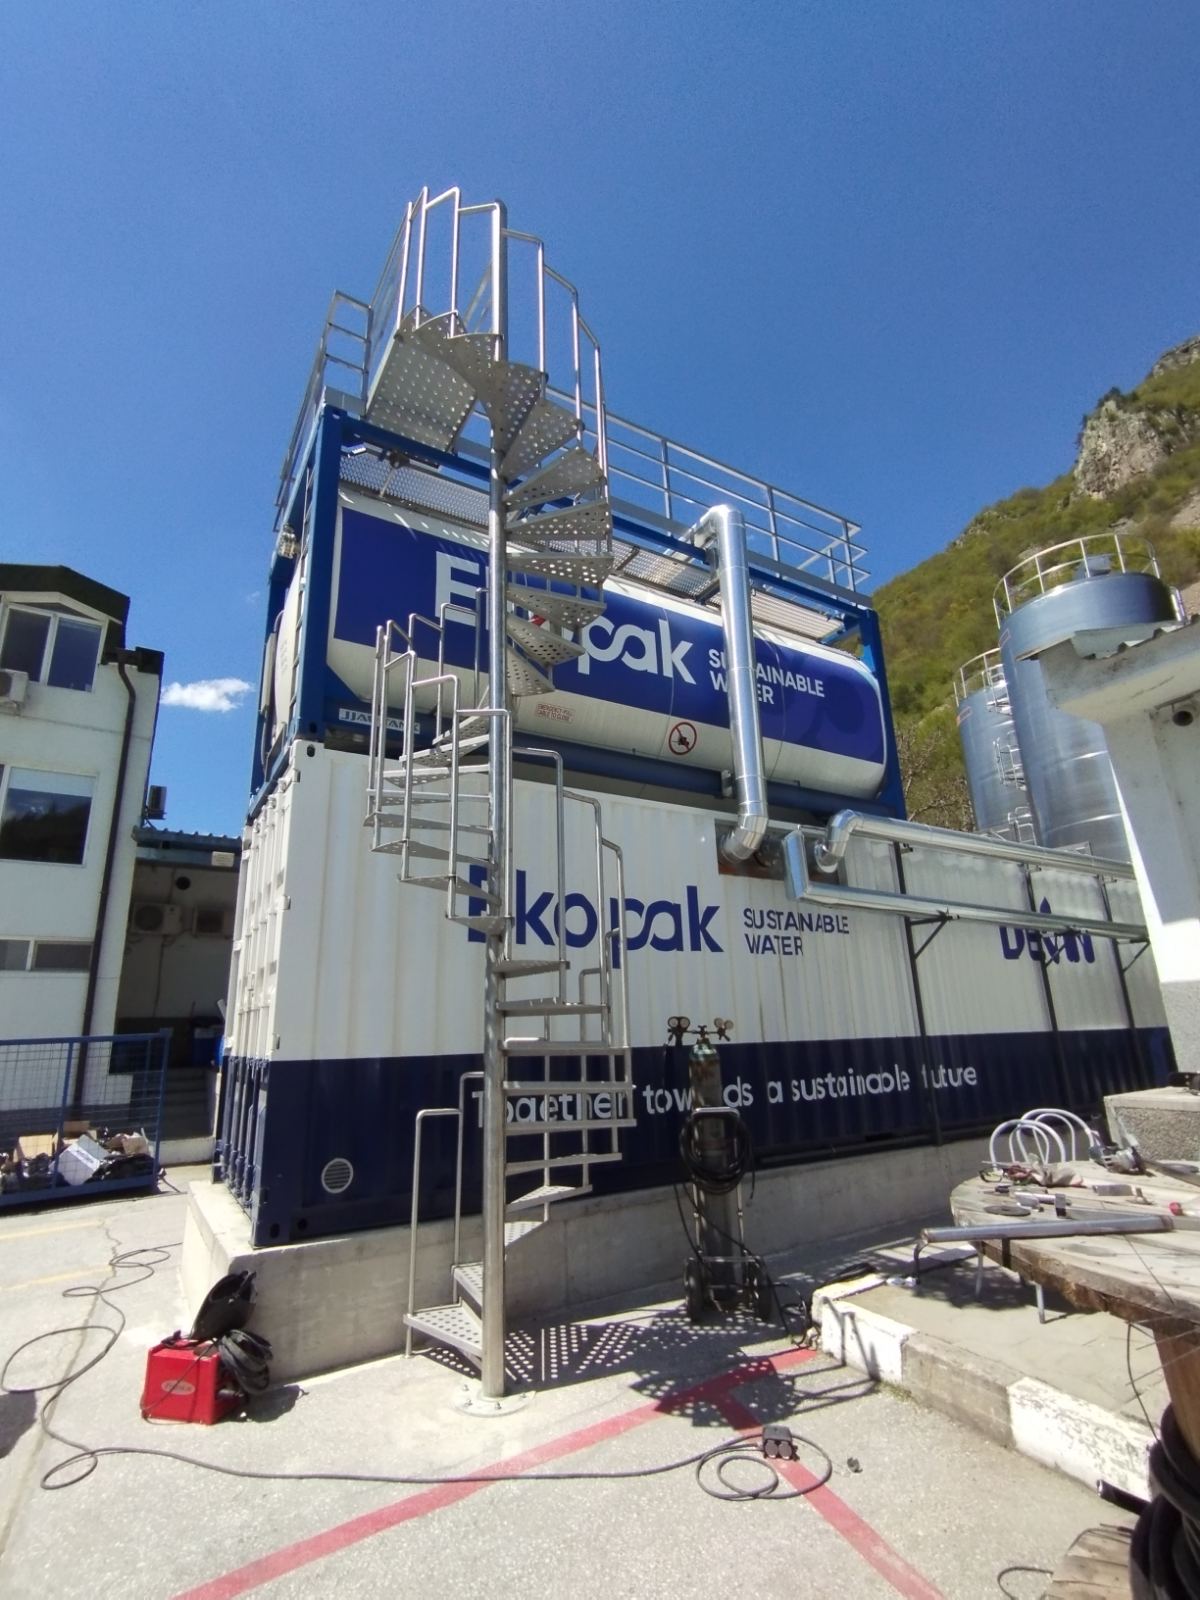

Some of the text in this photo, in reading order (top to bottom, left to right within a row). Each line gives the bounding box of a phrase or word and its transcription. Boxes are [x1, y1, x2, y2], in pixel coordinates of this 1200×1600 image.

[435, 550, 697, 685] Epak
[708, 648, 825, 698] SAINABLE
[744, 933, 803, 956] WATER
[643, 1076, 754, 1115] towds
[767, 1081, 784, 1104] a
